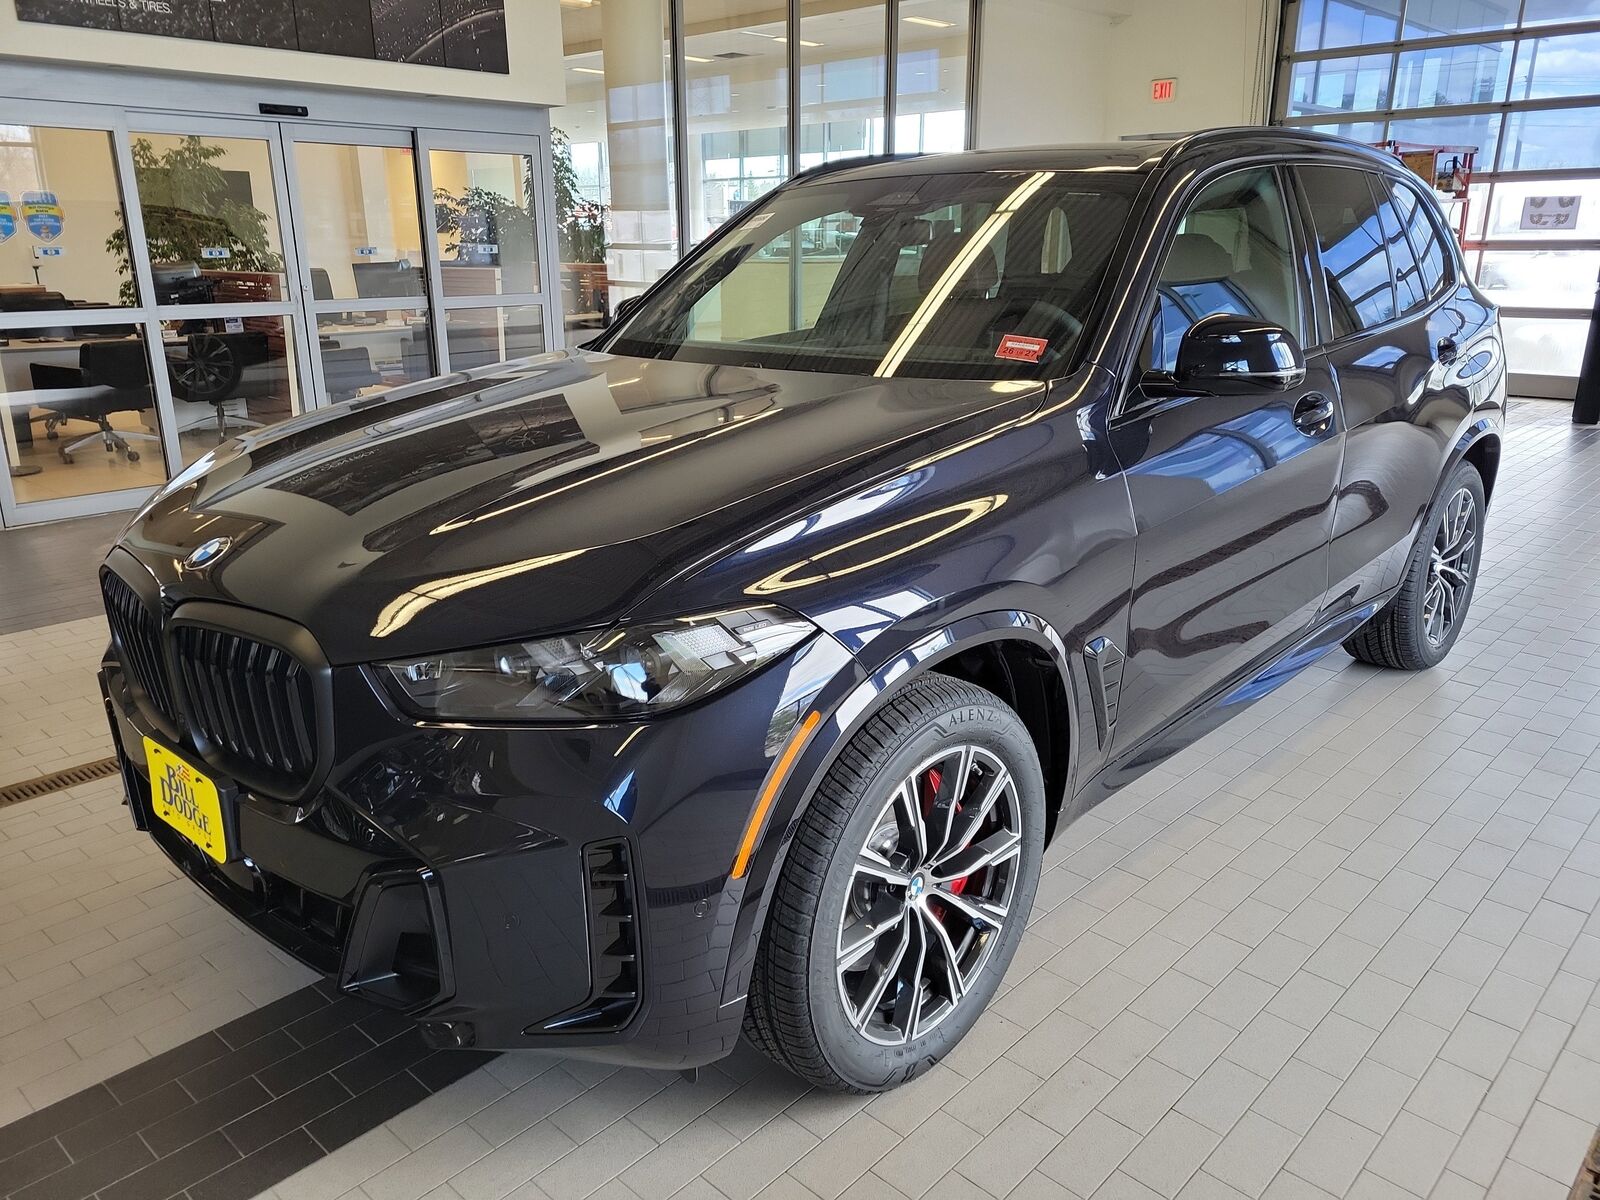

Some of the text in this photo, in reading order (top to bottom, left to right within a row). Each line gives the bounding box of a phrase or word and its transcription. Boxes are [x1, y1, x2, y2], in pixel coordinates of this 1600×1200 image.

[129, 0, 138, 9] &
[141, 0, 173, 14] TIRES.
[1153, 81, 1173, 100] EXIT
[1002, 347, 1014, 355] 26
[1024, 350, 1037, 358] 27
[160, 777, 212, 835] DODGE
